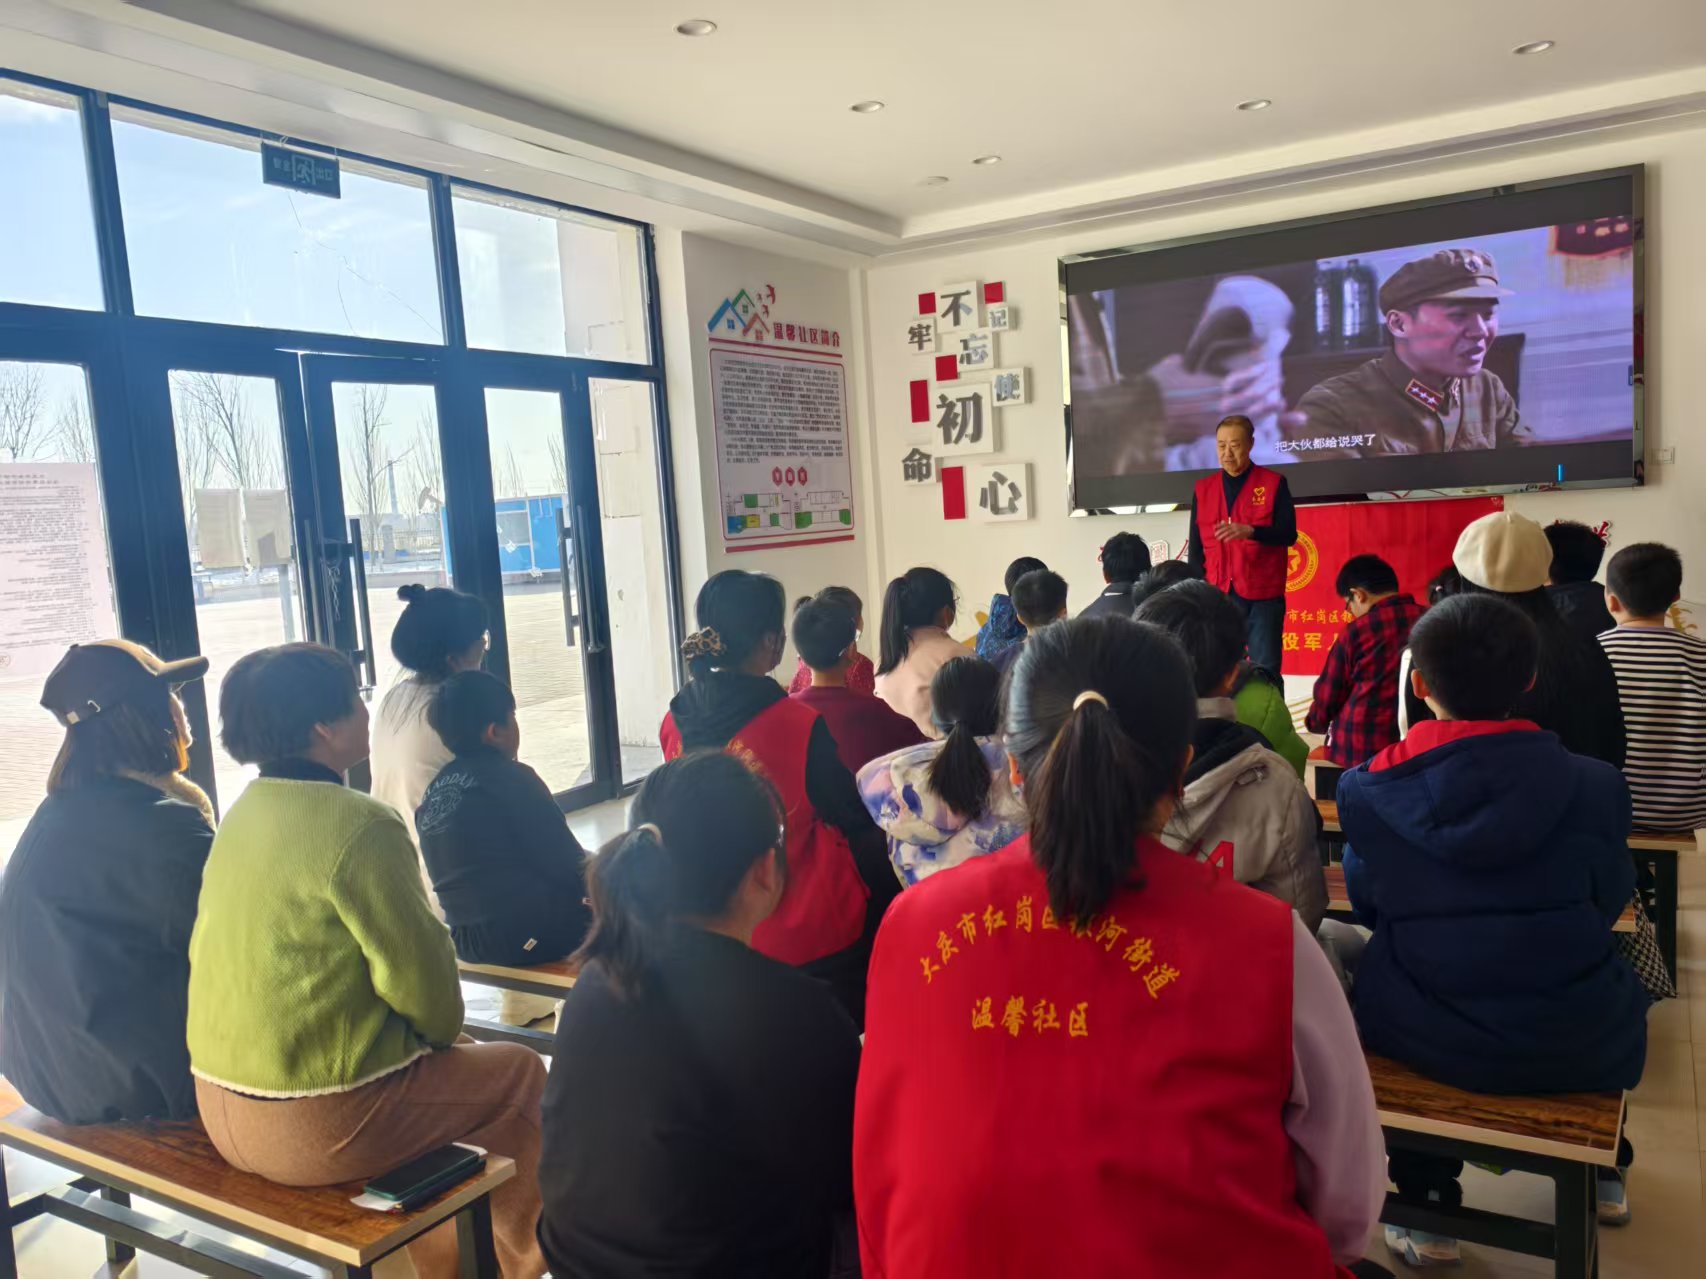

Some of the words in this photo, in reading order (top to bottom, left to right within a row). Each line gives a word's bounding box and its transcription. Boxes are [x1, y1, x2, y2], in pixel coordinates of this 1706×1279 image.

[1275, 433, 1376, 453] 把大伙都给说哭了
[971, 995, 1089, 1037] 温馨社区
